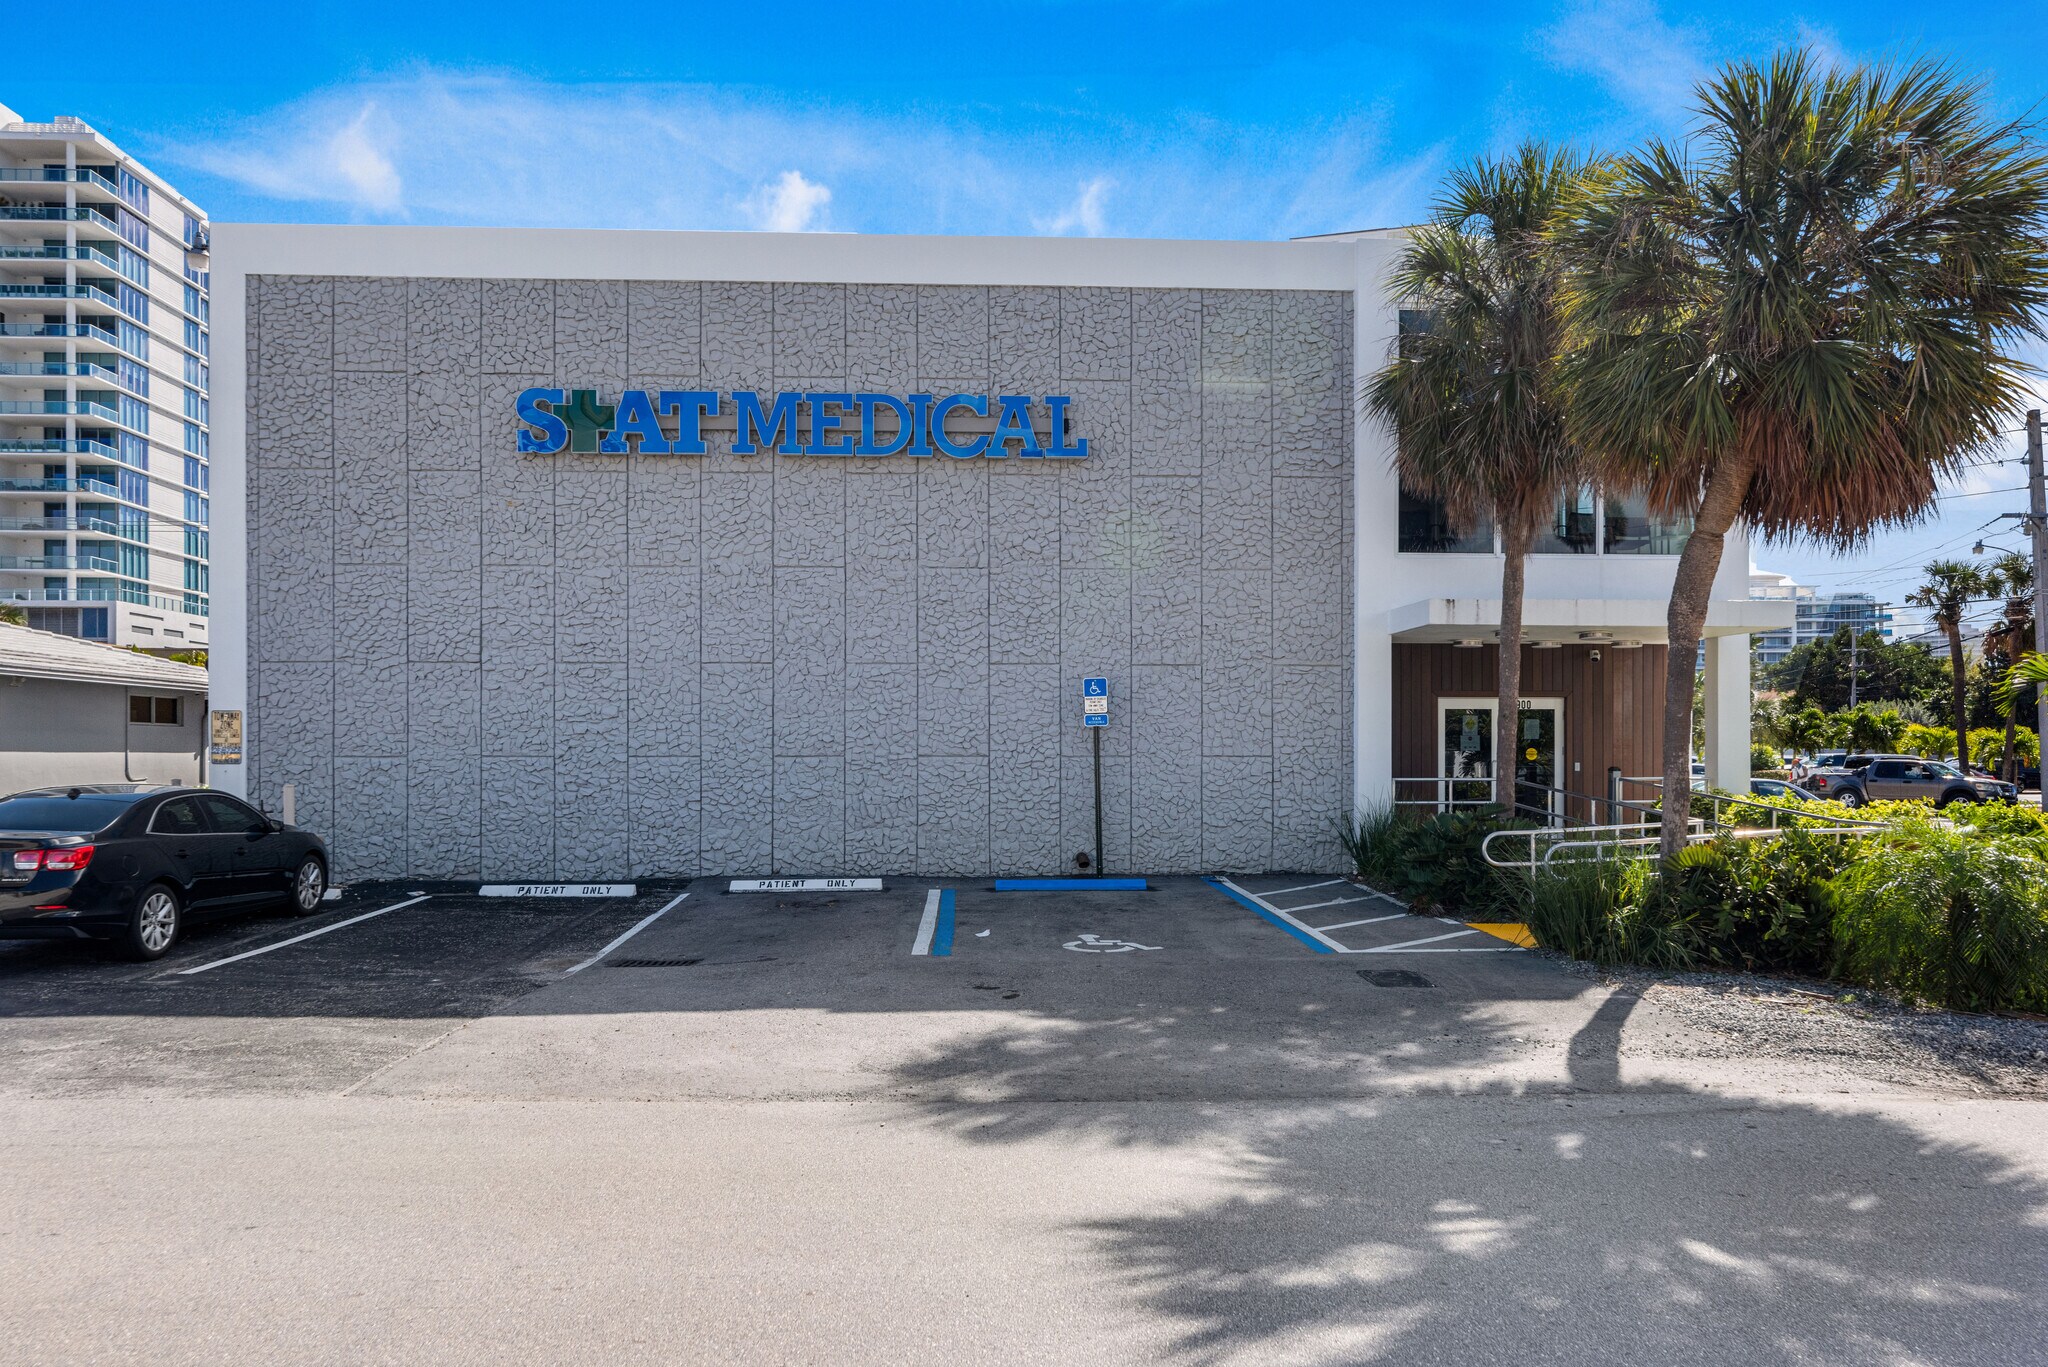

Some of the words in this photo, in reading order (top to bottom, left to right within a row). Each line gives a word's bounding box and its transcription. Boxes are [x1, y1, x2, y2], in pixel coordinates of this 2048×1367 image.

[730, 390, 1090, 460] MEDICAL
[759, 880, 806, 888] PATIENT
[827, 879, 856, 887] ONLY
[517, 886, 566, 895] PATIENT
[582, 886, 612, 895] ONLY
